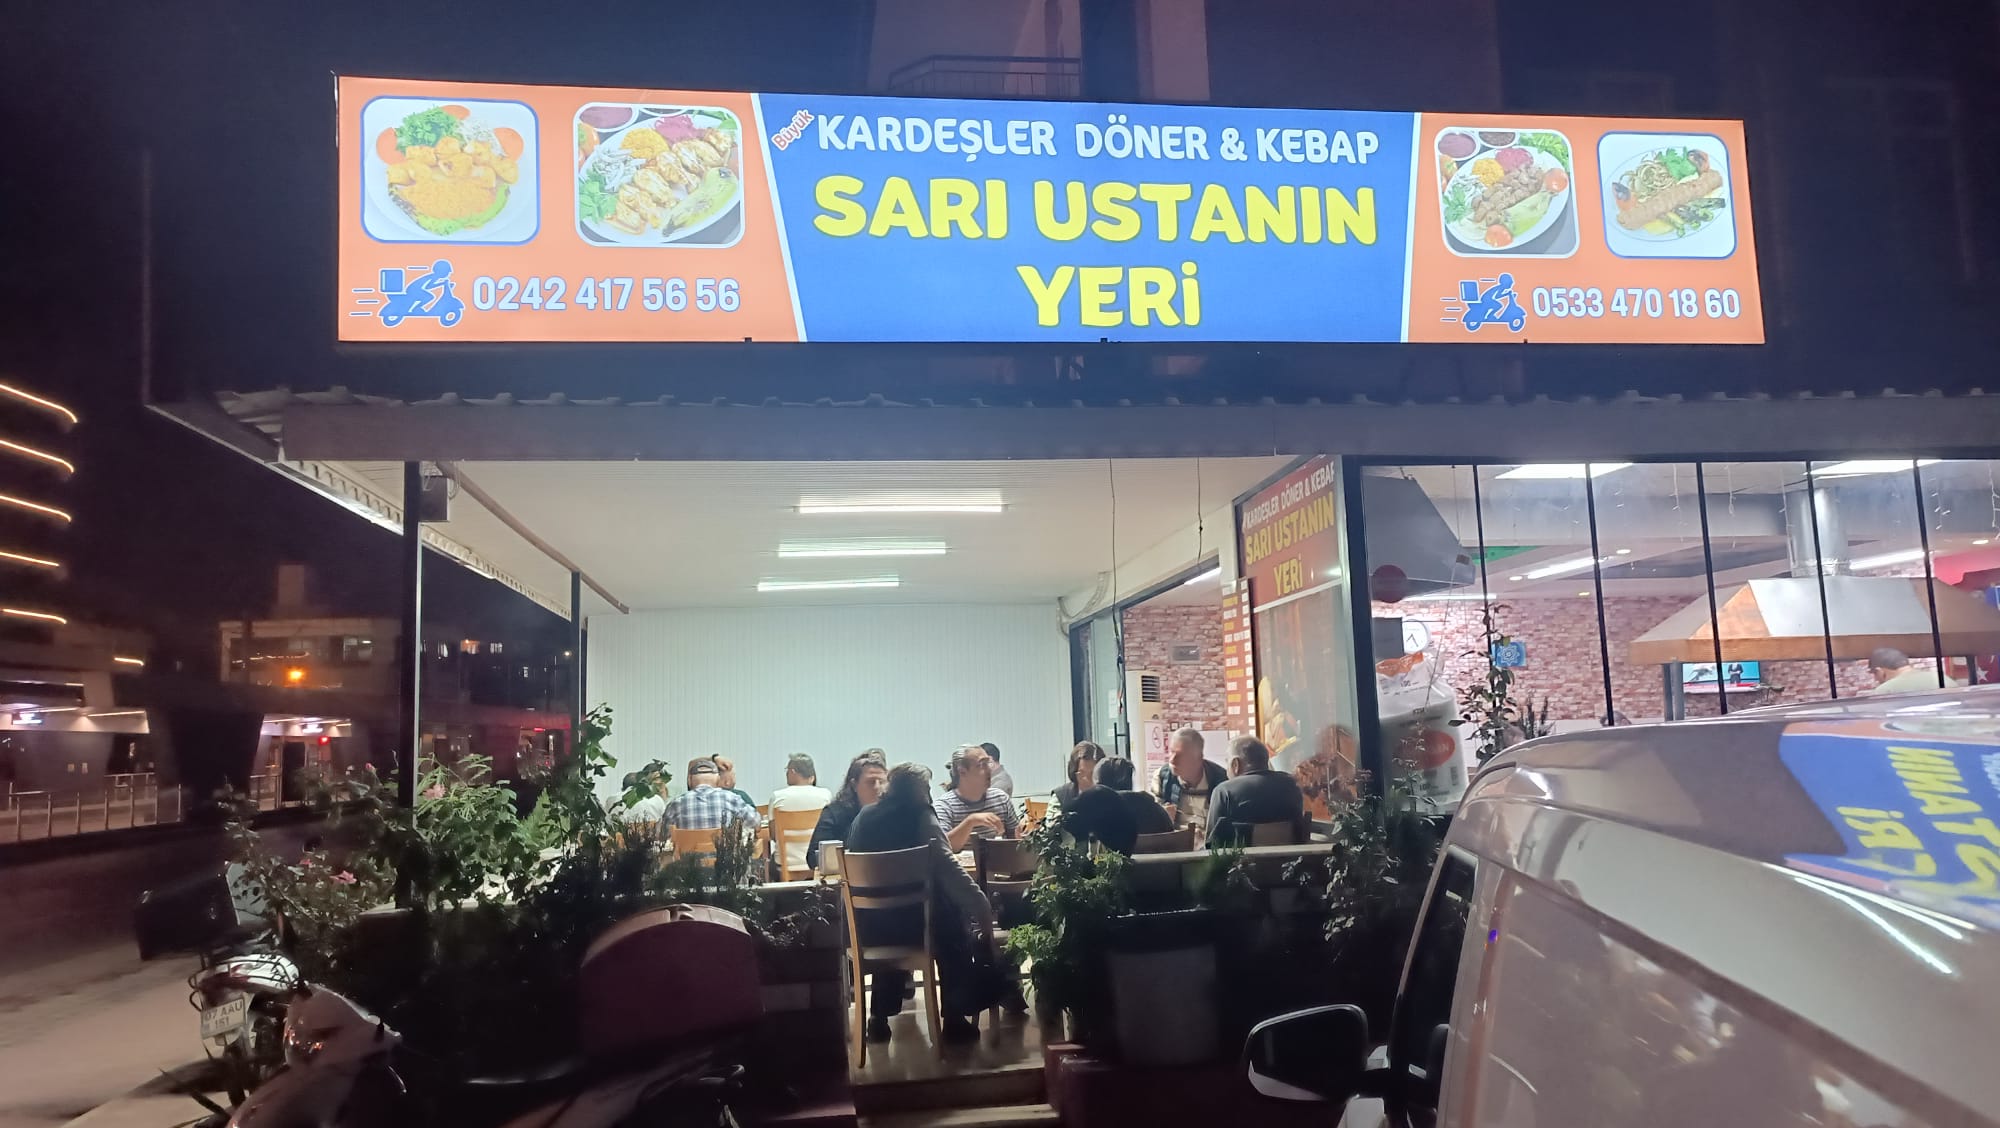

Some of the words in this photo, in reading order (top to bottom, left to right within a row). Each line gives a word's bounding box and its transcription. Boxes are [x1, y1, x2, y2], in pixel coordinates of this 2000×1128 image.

[771, 109, 815, 151] Büyük
[818, 114, 1057, 163] KARDEŞLER
[1075, 113, 1211, 161] DÖNER
[1220, 127, 1249, 161] &
[1256, 129, 1380, 164] KEBAP
[814, 175, 1008, 240] SARI
[1034, 180, 1379, 246] USTANIN
[472, 275, 567, 312] 0242
[575, 276, 634, 312] 417
[642, 278, 688, 312] 56
[695, 278, 741, 312] 56
[1532, 286, 1606, 319] 0533
[1610, 288, 1663, 319] 470
[1669, 288, 1700, 319] 18
[1704, 288, 1742, 320] 60
[1245, 495, 1280, 528] KARDEŞLER
[1281, 483, 1304, 510] DÖNER
[1304, 477, 1311, 497] &
[1246, 529, 1272, 565] SARI
[1274, 491, 1335, 552] USTANIN
